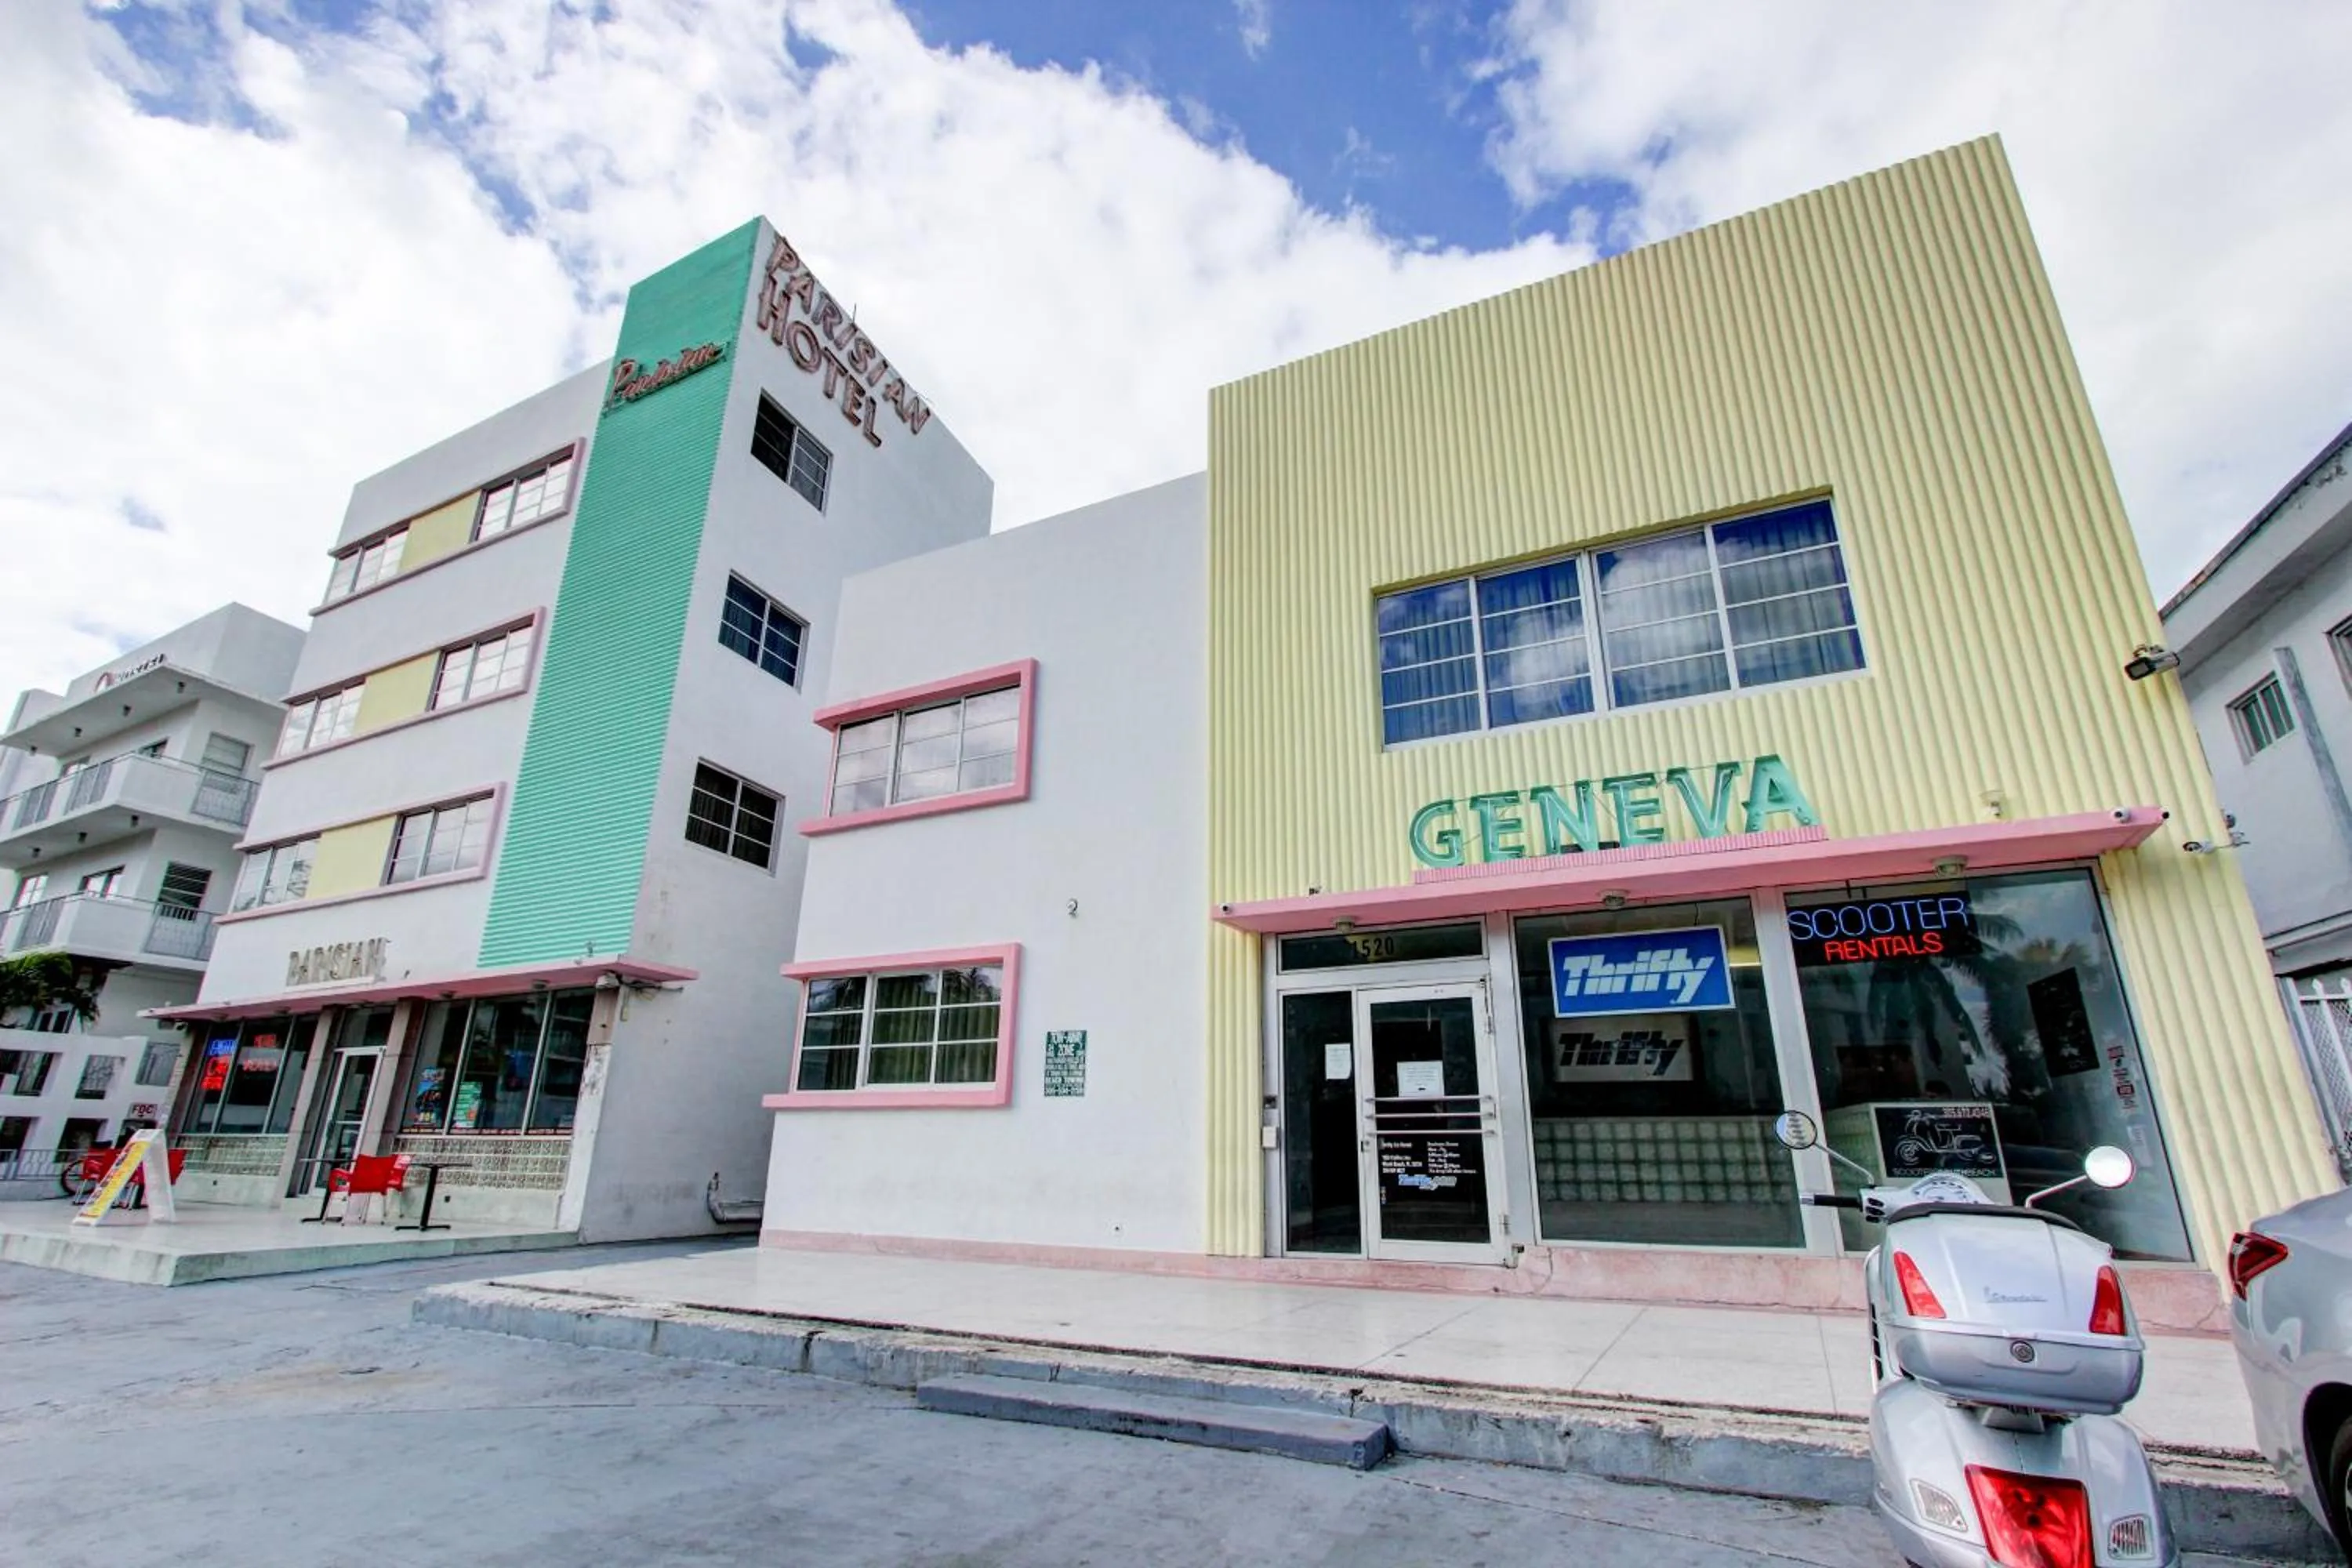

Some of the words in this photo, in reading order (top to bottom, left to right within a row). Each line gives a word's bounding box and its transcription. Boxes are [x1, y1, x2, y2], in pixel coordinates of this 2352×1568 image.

[757, 270, 882, 448] HOTEL
[767, 234, 931, 434] PARISIAN
[1410, 753, 1821, 868] GENEVA
[1787, 898, 1969, 940] SCOOTER
[1353, 936, 1394, 958] 1520
[1824, 931, 1944, 963] RENTALS
[1563, 948, 1715, 1004] Thrifty
[1559, 1030, 1685, 1076] Thrifty
